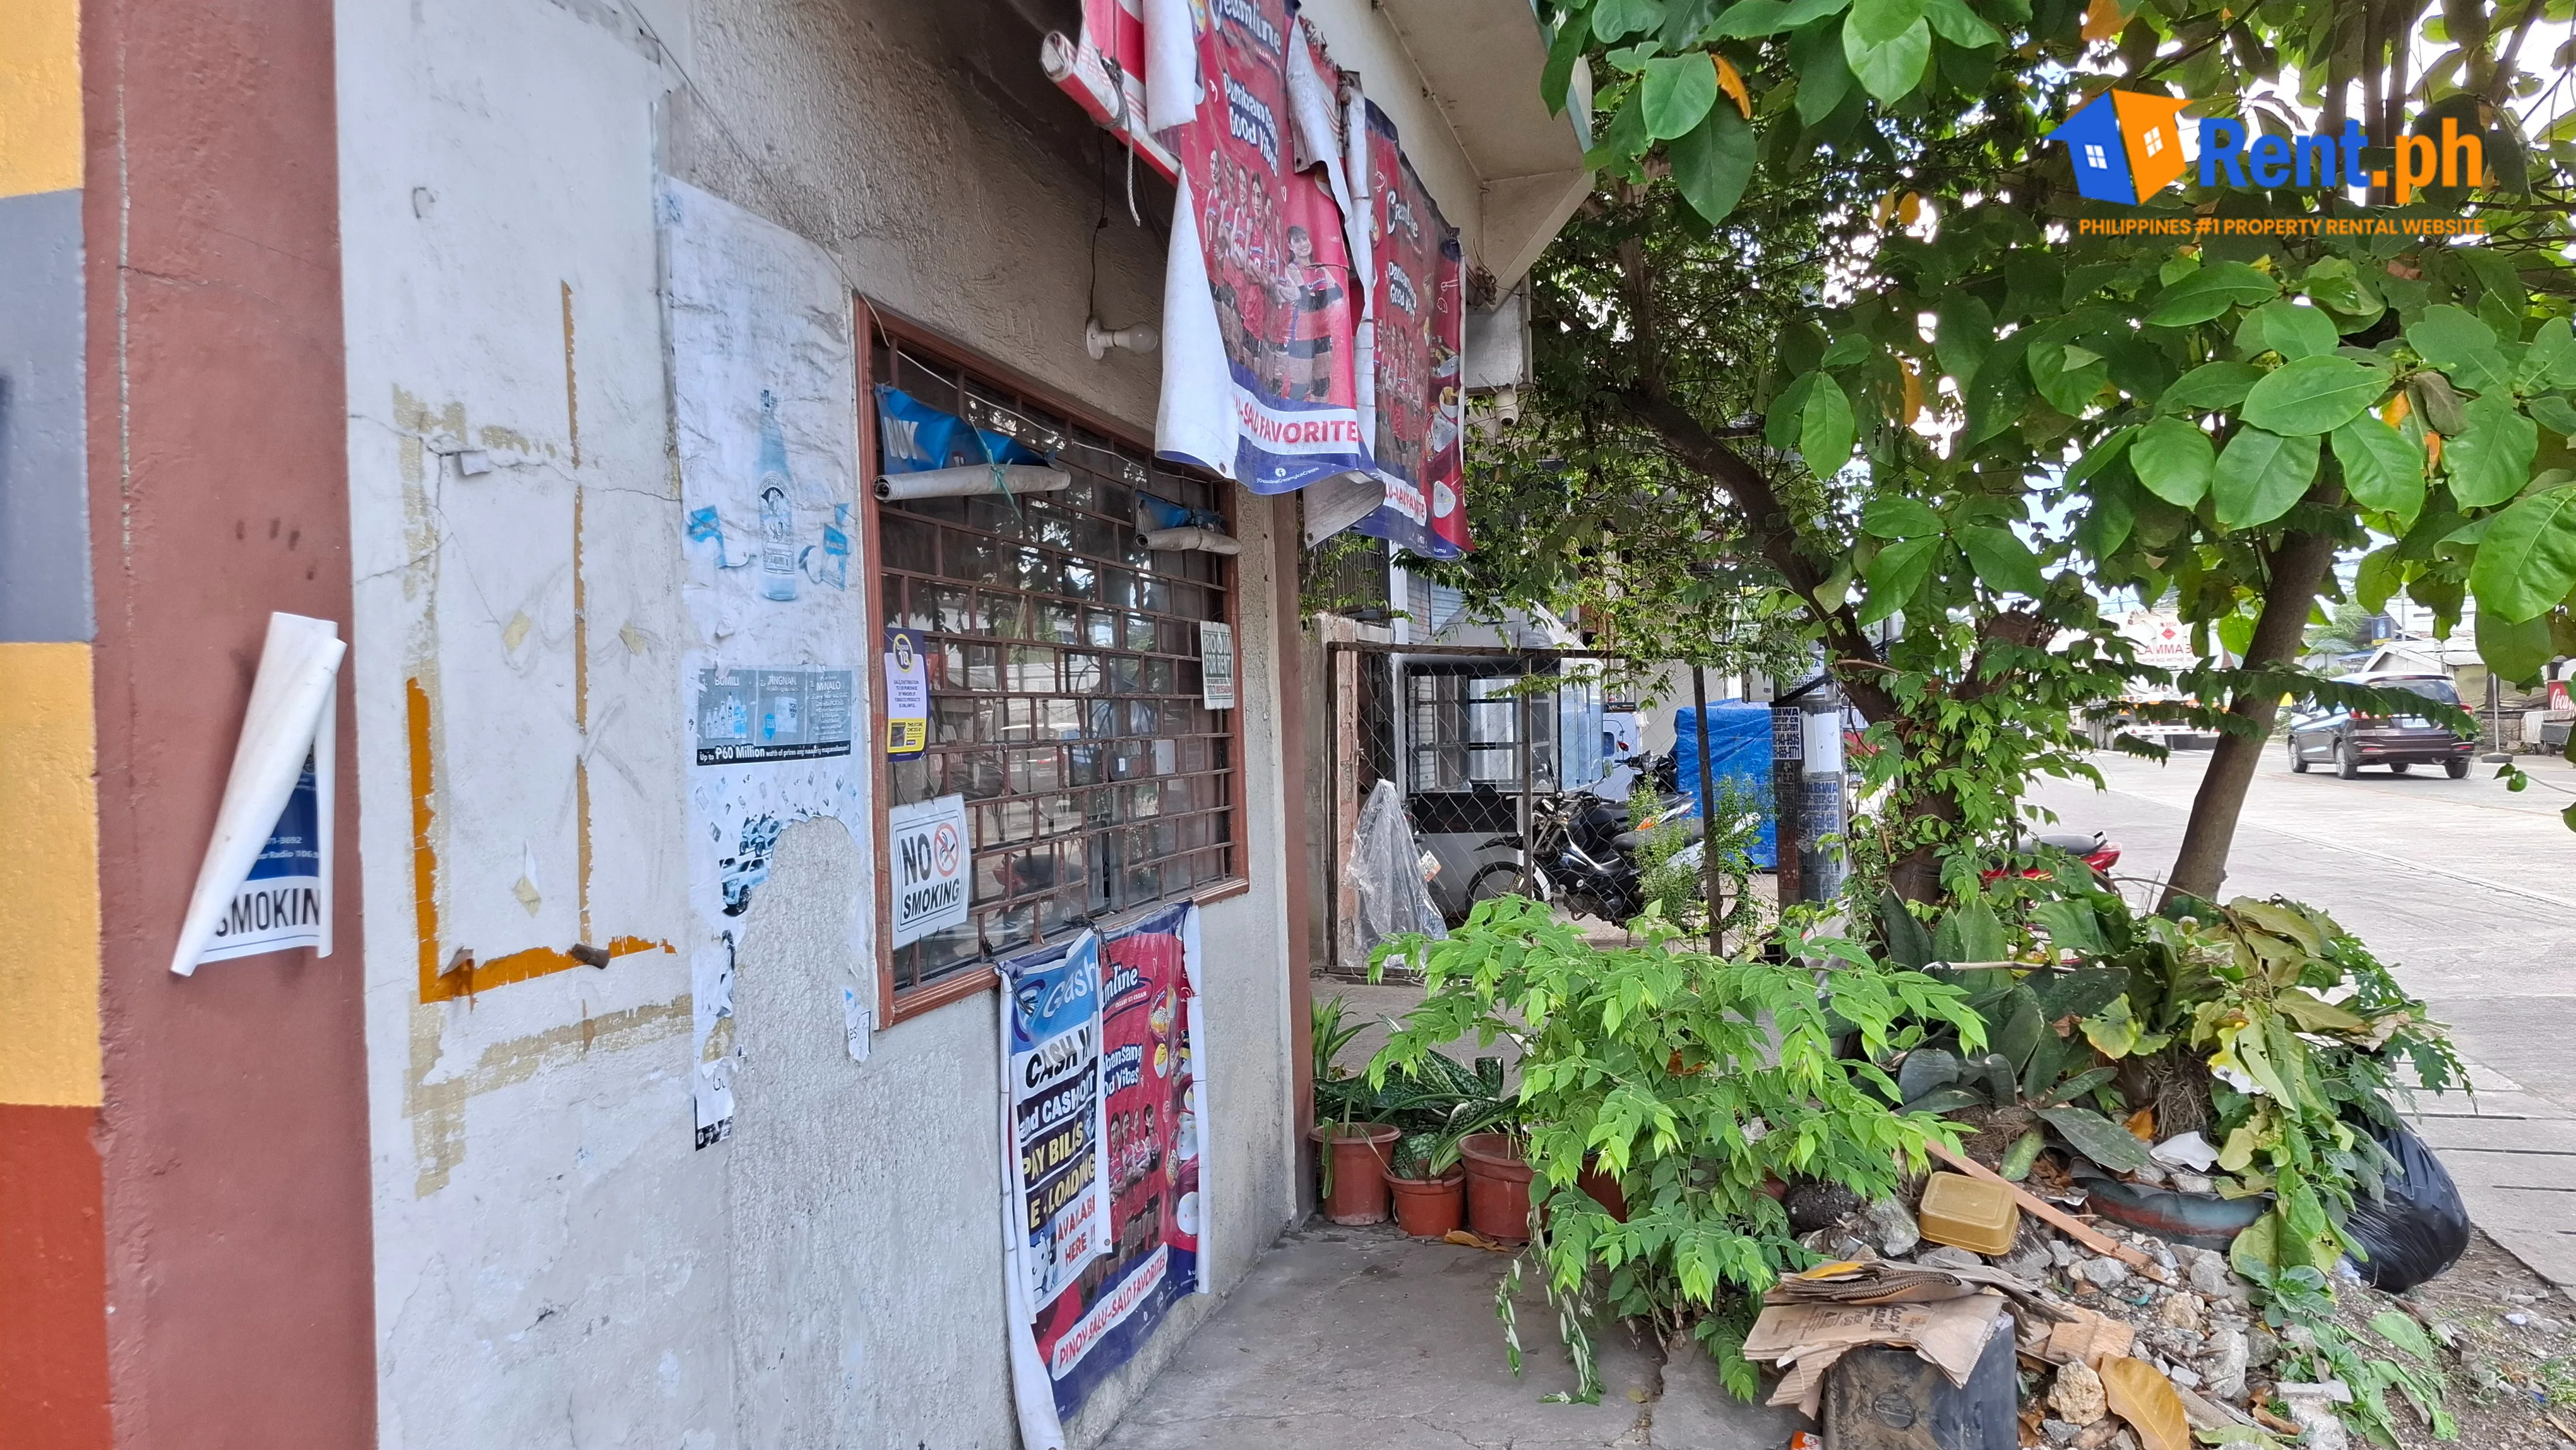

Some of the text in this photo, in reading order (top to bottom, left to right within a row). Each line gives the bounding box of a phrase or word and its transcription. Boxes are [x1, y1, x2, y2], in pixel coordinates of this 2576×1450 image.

[1258, 416, 1362, 445] FAVORITE
[1204, 634, 1231, 654] ROOM
[1206, 654, 1231, 674] FOR RENT
[700, 753, 708, 762] Up
[736, 745, 765, 758] Million
[900, 833, 933, 887] NO
[215, 888, 321, 937] SMOKIN
[903, 878, 960, 920] SMOKING
[1133, 991, 1147, 1002] CREAM
[1025, 1034, 1078, 1089] CASH
[1116, 1067, 1139, 1091] Vibes
[1019, 1106, 1039, 1139] and
[1023, 1144, 1046, 1182] PAY
[1065, 1231, 1087, 1267] HERE
[1058, 1332, 1087, 1369] PINOY
[1131, 1252, 1166, 1300] FAVORITES
